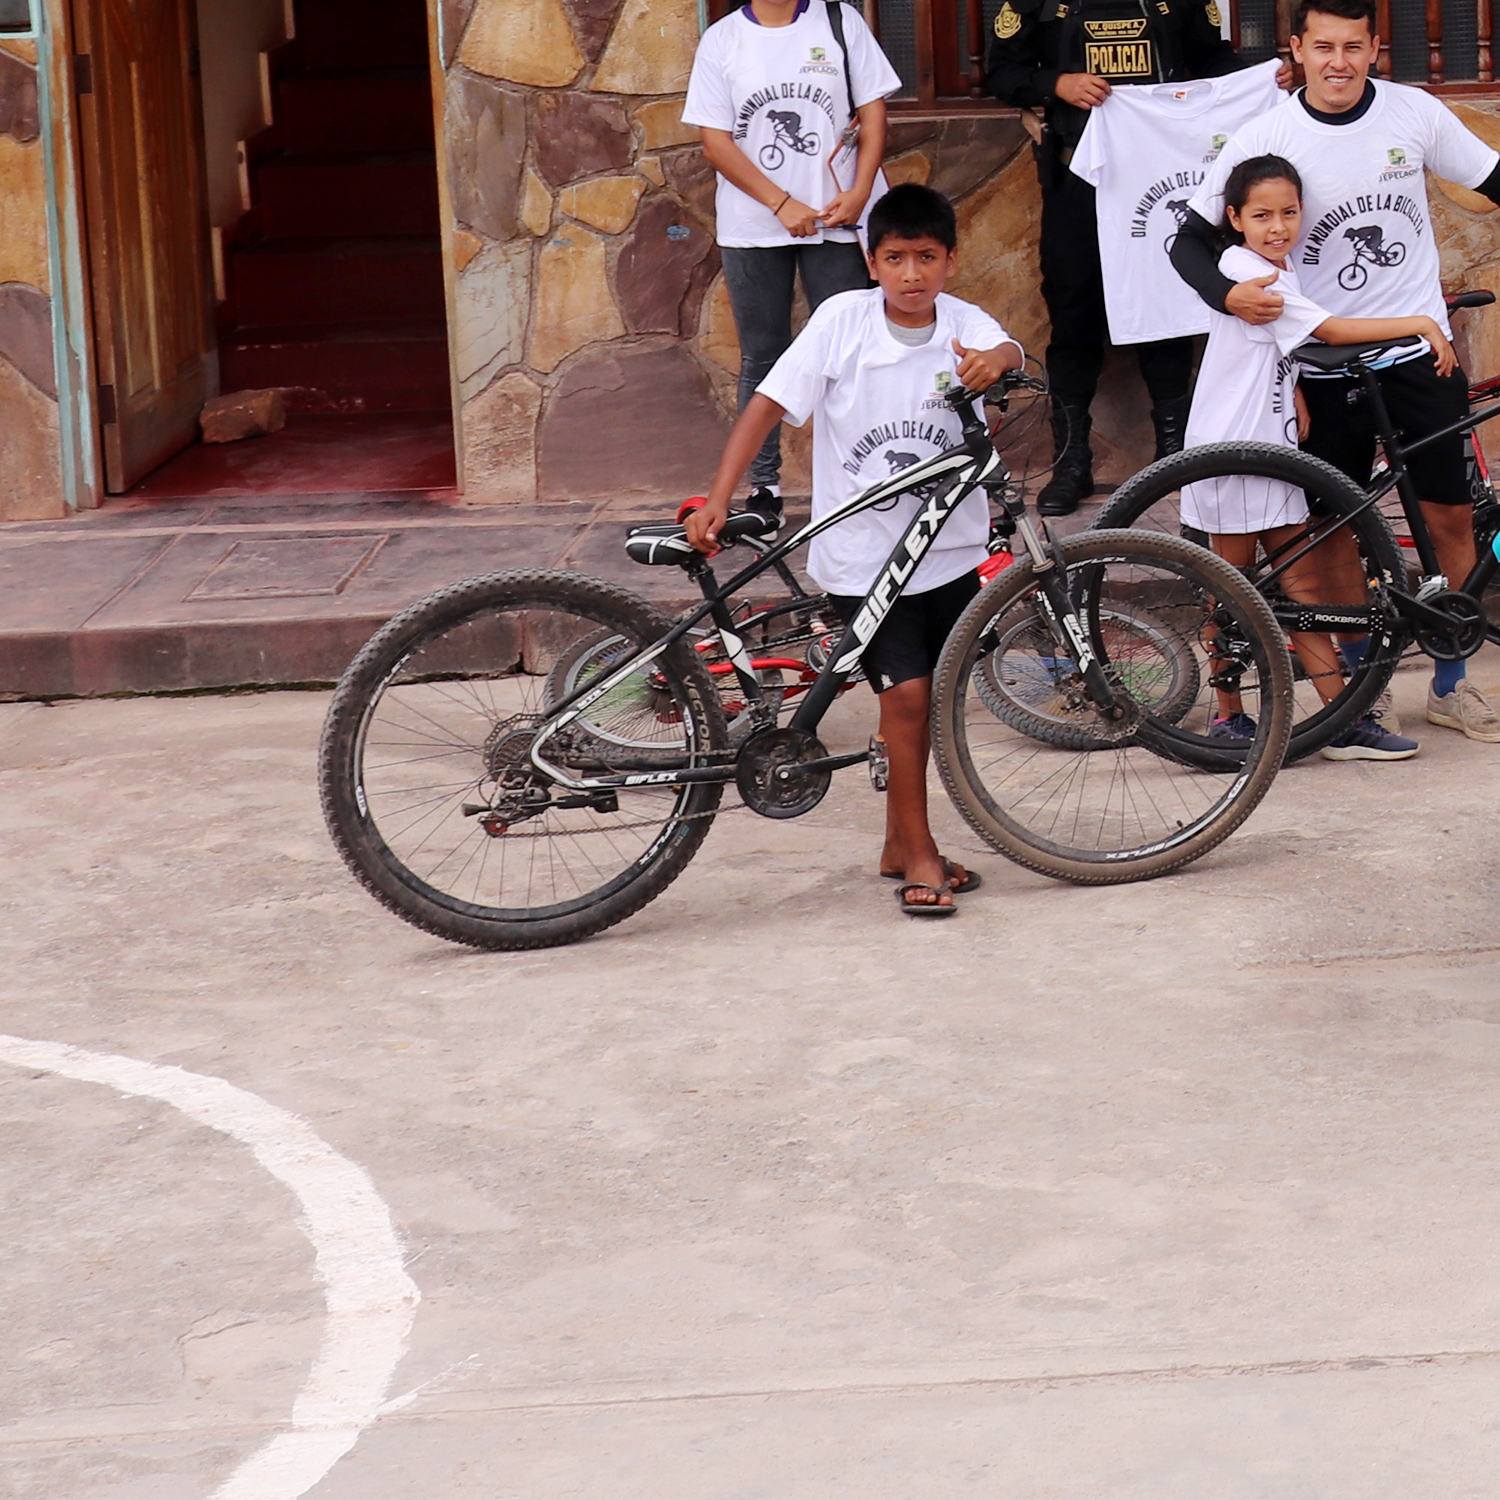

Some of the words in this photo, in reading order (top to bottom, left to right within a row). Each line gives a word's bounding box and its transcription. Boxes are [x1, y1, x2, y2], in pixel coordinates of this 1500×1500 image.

[1102, 21, 1134, 31] QUISPE
[1090, 44, 1148, 74] POLICIA
[799, 66, 838, 76] JEPELACIO
[781, 83, 795, 98] DE
[797, 83, 812, 99] LA
[739, 84, 780, 122] MUNDIAL
[735, 120, 749, 140] DIA
[1175, 171, 1190, 188] DE
[1378, 167, 1420, 182] JEPELACIO
[1134, 177, 1176, 219] MUNDIAL
[1356, 195, 1373, 213] DE
[1377, 194, 1392, 211] LA
[1308, 202, 1357, 246] MUNDIAL
[1392, 195, 1424, 238] BICICLETA
[1130, 220, 1148, 238] DIA
[1302, 245, 1320, 265] DIA
[851, 422, 900, 460] MUNDIAL
[902, 420, 917, 438] DE
[918, 422, 933, 441] LA
[851, 495, 948, 645] BIFLEX
[1065, 556, 1128, 571] BIFLEX
[1314, 613, 1369, 625] ROCKBROS
[1064, 612, 1096, 662] BIFLEX
[683, 674, 712, 752] VECTOR
[624, 771, 679, 786] BIFLEX
